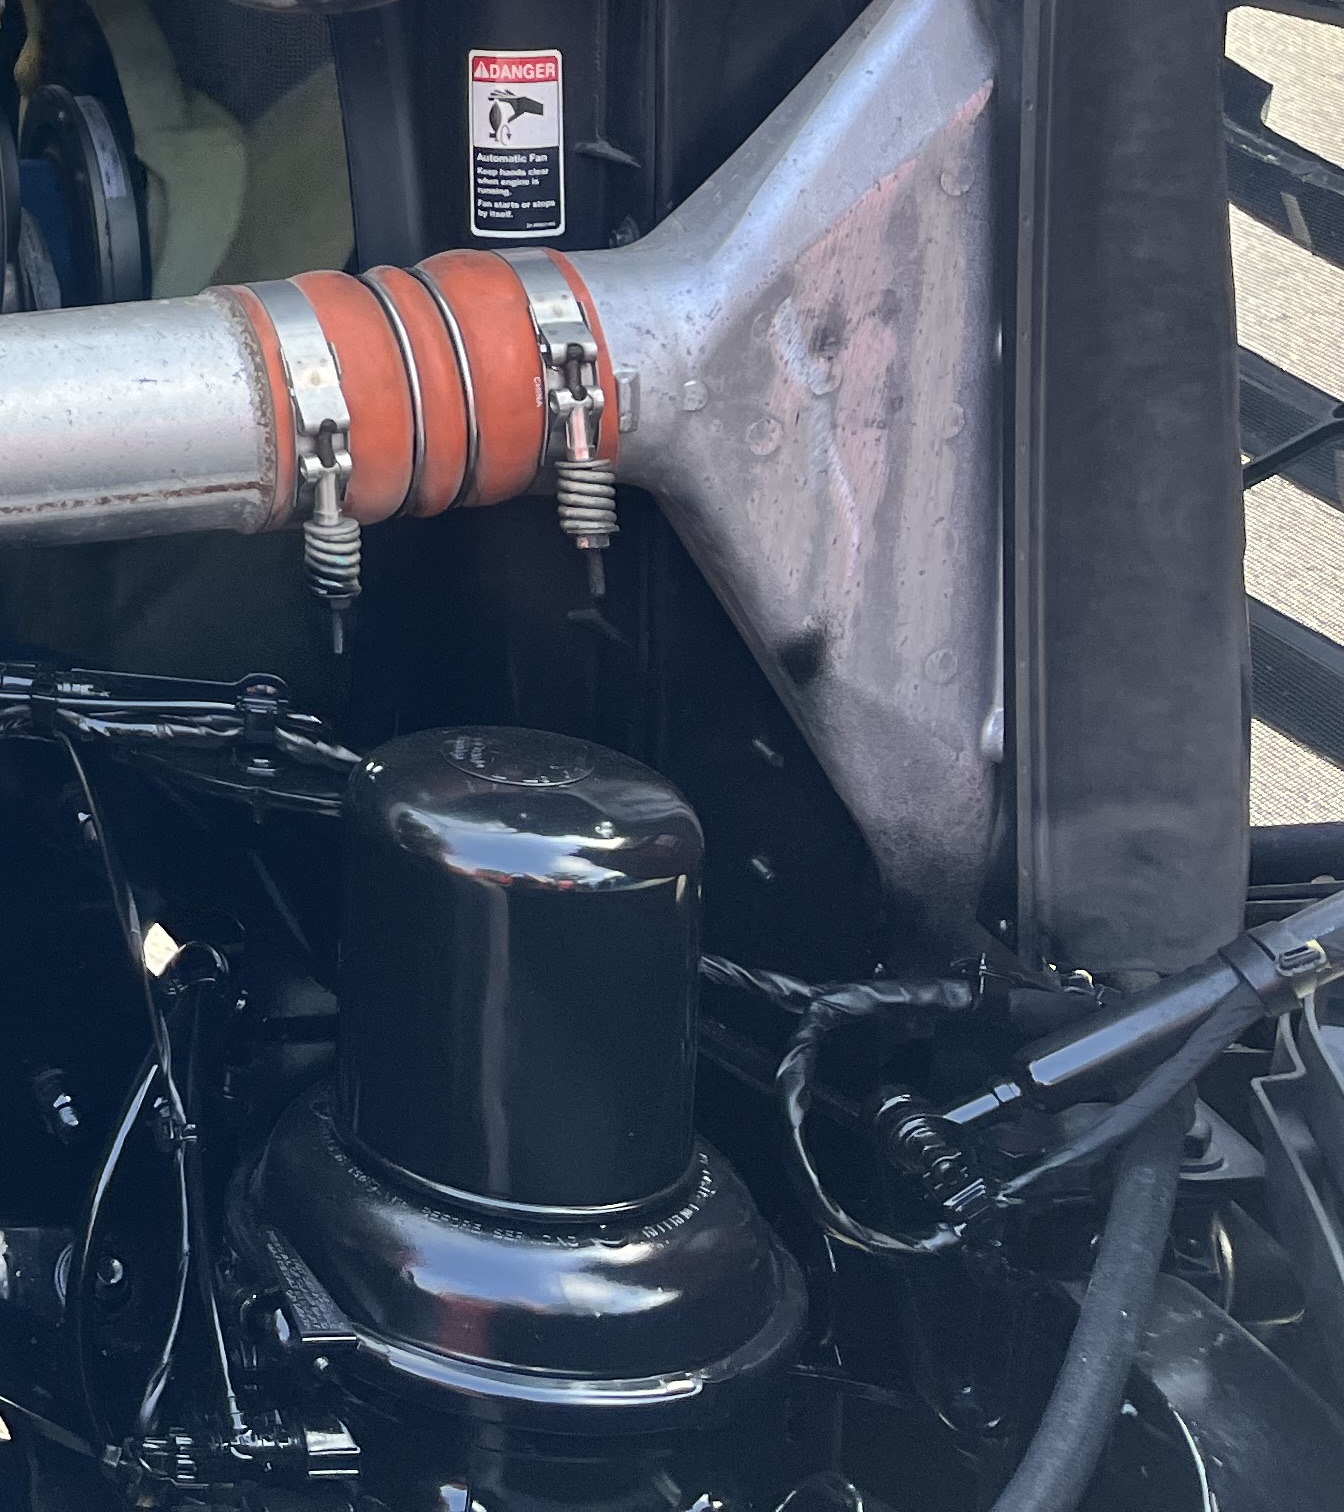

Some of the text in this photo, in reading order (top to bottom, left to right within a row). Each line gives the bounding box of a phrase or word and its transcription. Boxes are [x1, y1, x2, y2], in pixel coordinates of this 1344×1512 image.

[490, 63, 555, 80] DANGER
[477, 153, 548, 163] Automatic Fan
[477, 167, 498, 177] Keep
[528, 168, 549, 176] clear
[477, 177, 499, 185] when
[500, 179, 530, 187] engine
[477, 187, 511, 197] running.
[477, 199, 493, 207] Fan
[533, 200, 556, 208] stops
[477, 209, 513, 218] by itself.
